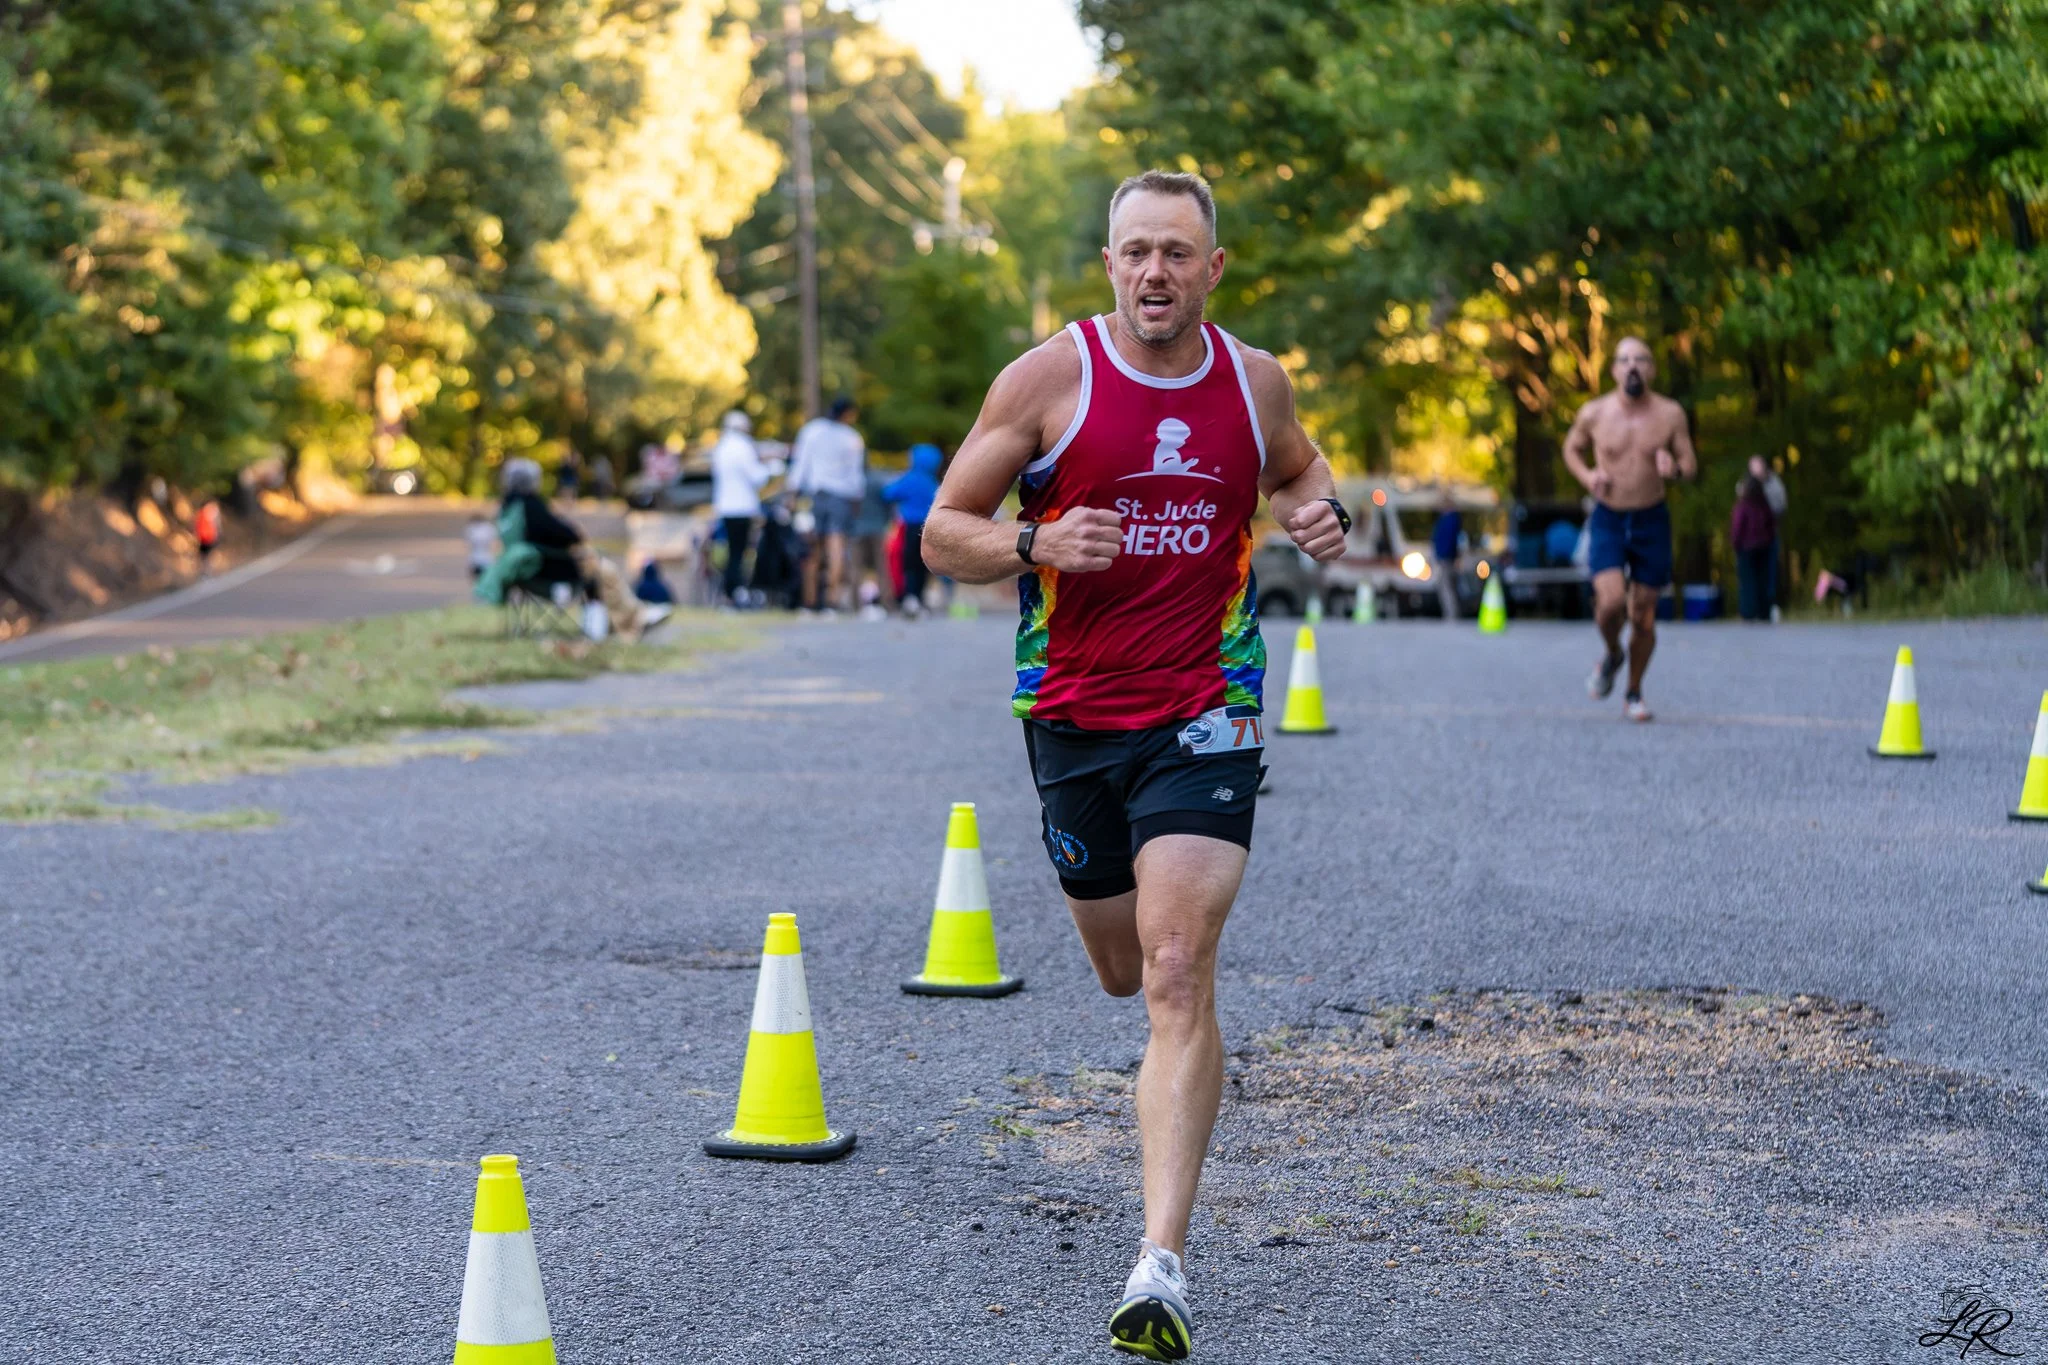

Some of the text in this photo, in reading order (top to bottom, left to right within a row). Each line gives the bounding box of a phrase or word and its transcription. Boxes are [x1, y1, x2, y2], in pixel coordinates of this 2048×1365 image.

[1115, 498, 1217, 521] St. Jude
[1122, 524, 1210, 555] HERO
[1231, 718, 1263, 747] 71
